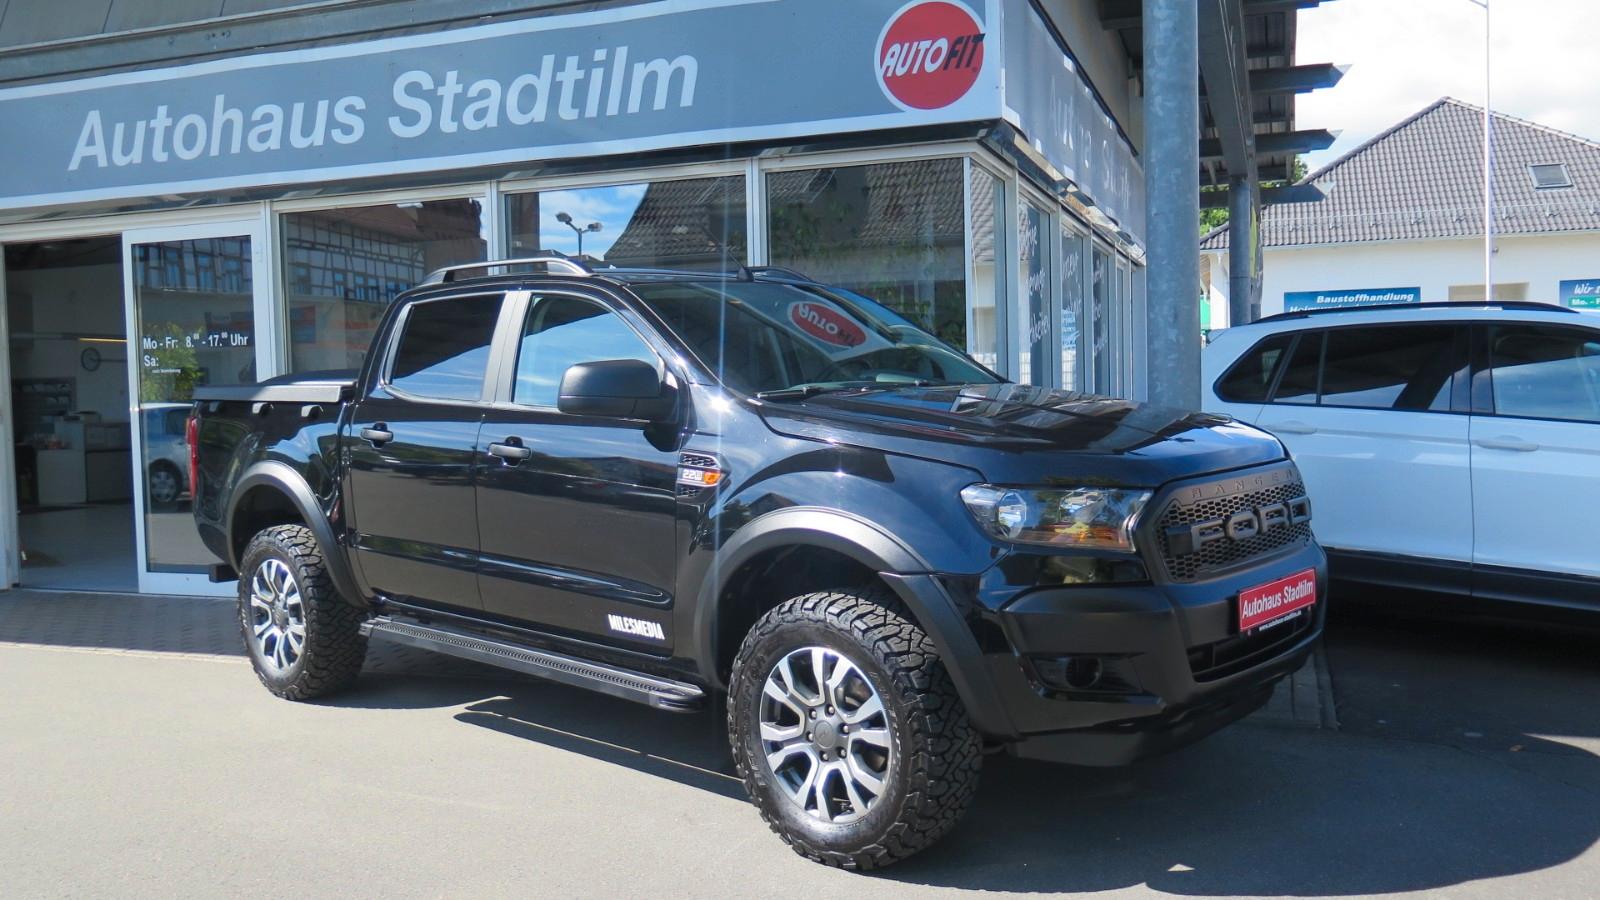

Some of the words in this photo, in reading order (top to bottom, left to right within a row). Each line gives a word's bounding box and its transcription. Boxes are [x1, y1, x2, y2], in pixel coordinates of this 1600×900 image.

[882, 33, 985, 77] AUTOFIT
[68, 95, 366, 171] Autohaus
[388, 46, 699, 138] Stadtilm
[1316, 293, 1415, 304] Baustoffhandlung
[143, 337, 158, 350] Mo
[230, 332, 249, 347] Uhr
[143, 354, 159, 367] Sa:
[1191, 497, 1312, 551] FORD
[1242, 592, 1282, 619] Autohaus
[1283, 579, 1313, 604] Stadtilm
[608, 613, 666, 640] MILESMEDIA
